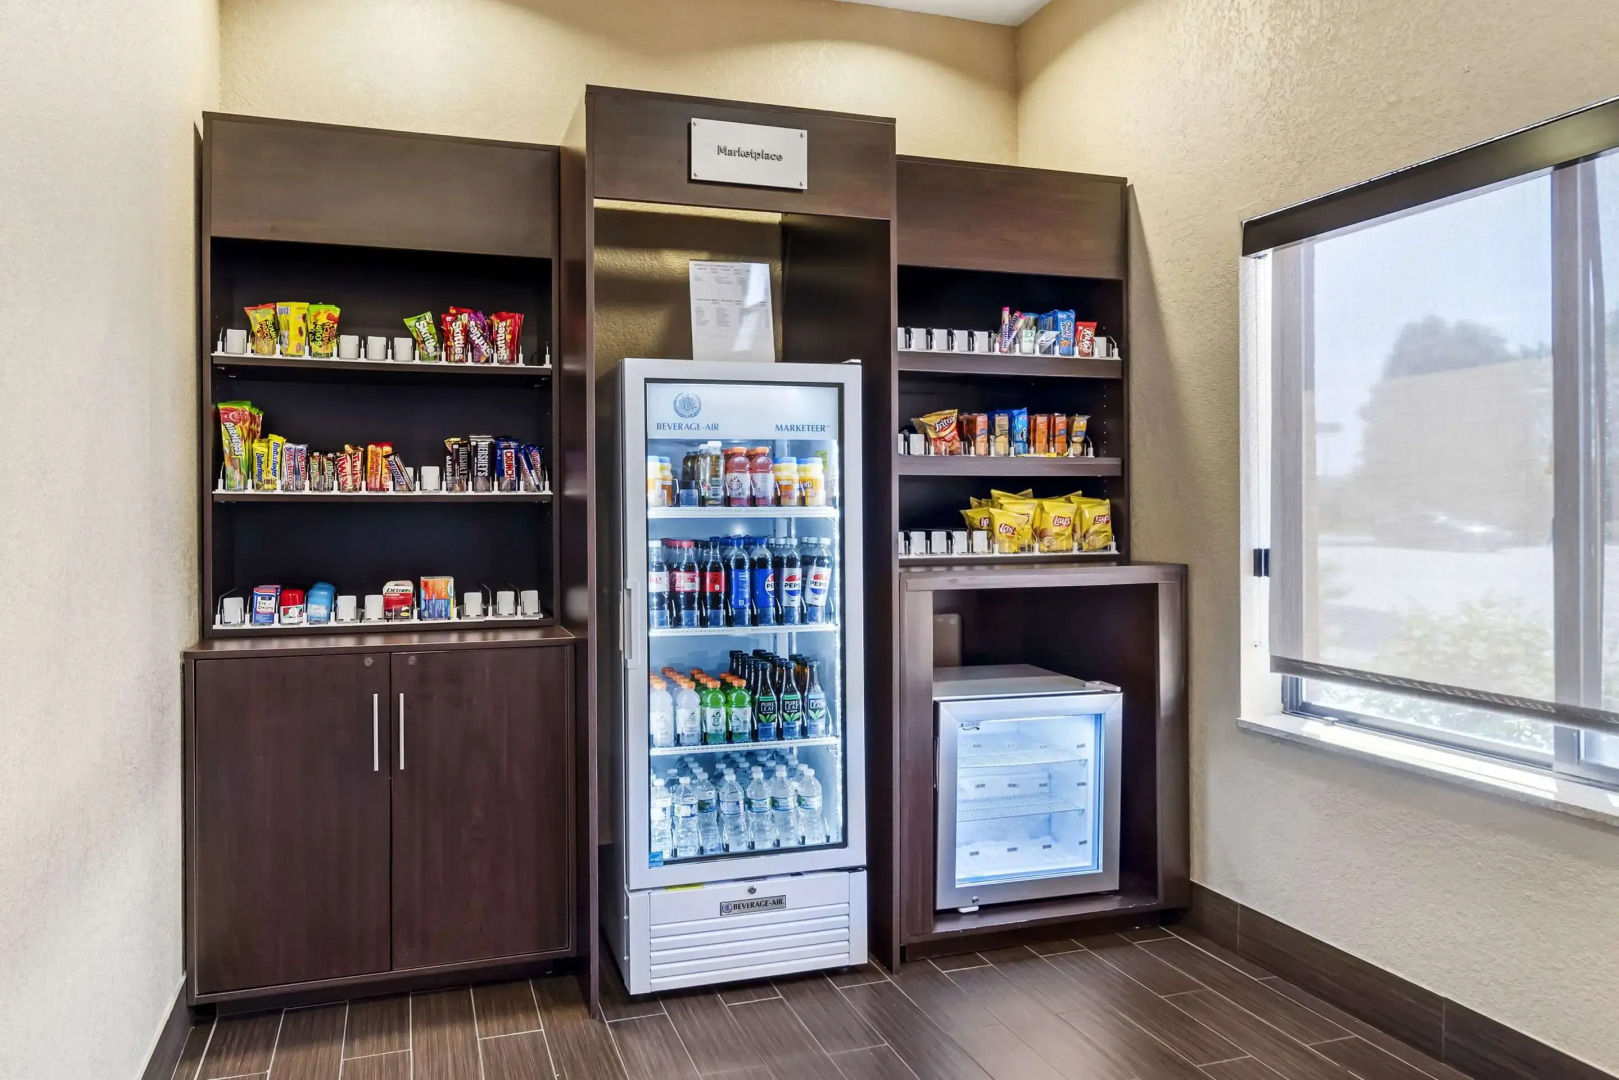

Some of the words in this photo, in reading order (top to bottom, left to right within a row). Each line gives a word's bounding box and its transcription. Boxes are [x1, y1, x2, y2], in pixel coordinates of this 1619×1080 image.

[717, 145, 783, 161] Marketplace
[452, 320, 464, 360] Skittles
[469, 321, 493, 357] Skittles
[496, 322, 508, 360] Skittles
[224, 422, 243, 456] AIRHEADS
[656, 422, 719, 431] BEVERAGE-AIR
[775, 424, 826, 432] MARKETEER
[255, 453, 265, 482] Butterfinger
[271, 441, 281, 478] Butterfinger
[337, 455, 349, 486] TWIX
[352, 452, 360, 485] TWIX
[477, 442, 489, 477] HERSHEY'S
[505, 450, 515, 480] CRUNCH
[733, 898, 783, 910] BEVERAGE-AIR
